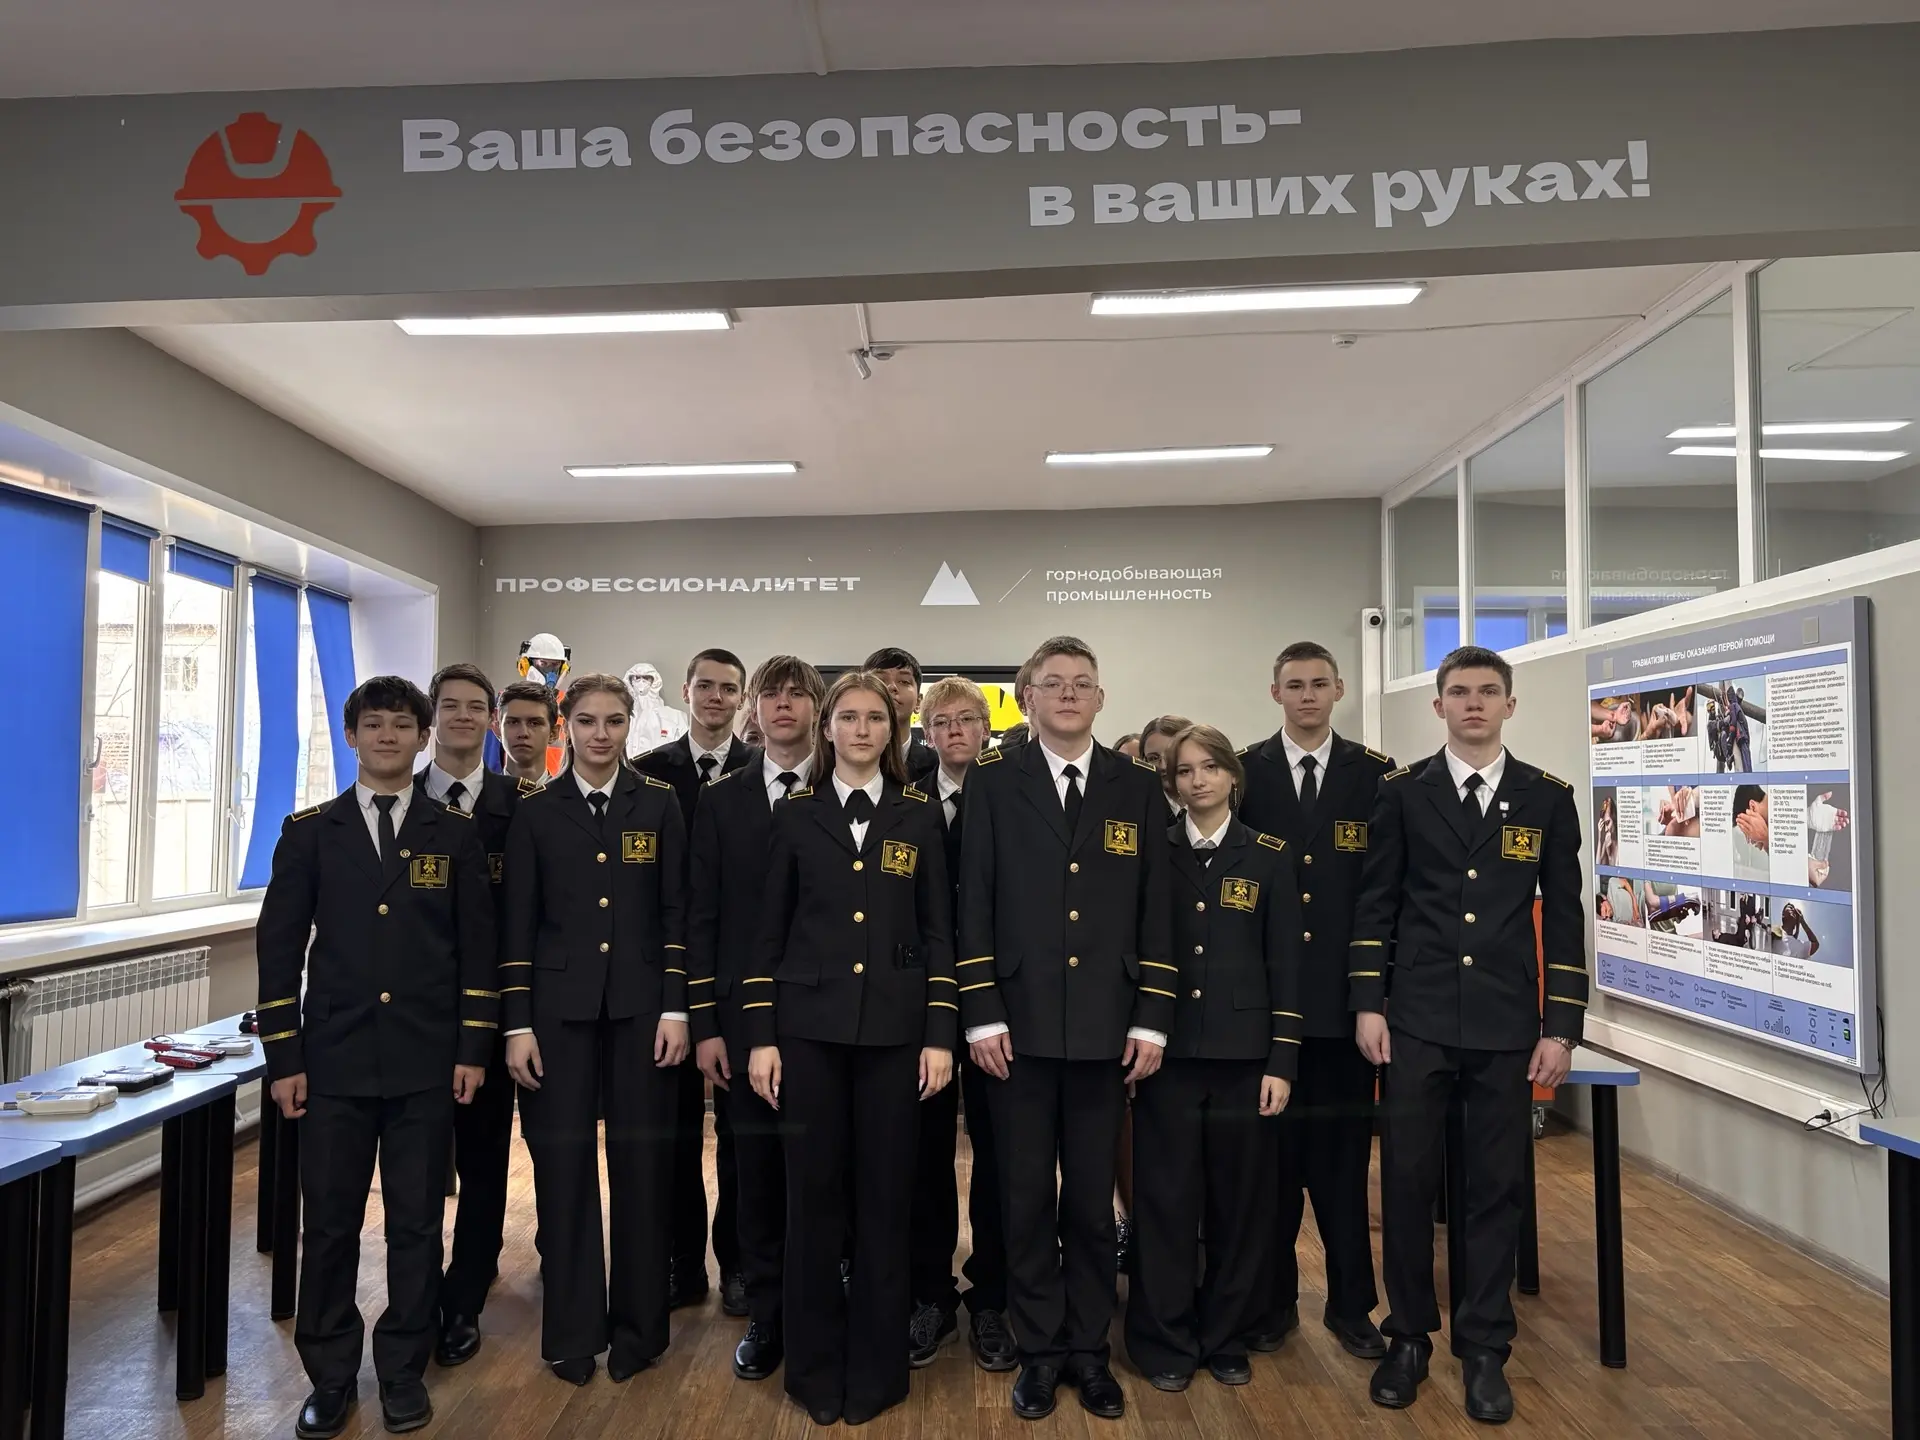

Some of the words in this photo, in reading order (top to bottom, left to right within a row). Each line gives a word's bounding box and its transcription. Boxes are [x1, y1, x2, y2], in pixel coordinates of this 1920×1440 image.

[402, 119, 632, 172] Ваша
[649, 105, 1302, 165] безопасность-
[1029, 186, 1075, 227] в
[1093, 174, 1357, 224] ваших
[1372, 140, 1651, 228] руках!
[495, 577, 861, 593] ПРОФЕССИОНАЛИТЕТ
[1046, 566, 1222, 584] горнодобывающая
[1046, 588, 1213, 604] промышленность
[1632, 655, 1664, 668] ТРАВМАТИЗМ
[1670, 652, 1685, 662] МЕРЫ
[1687, 645, 1717, 658] ОКАЗАНИЯ
[1718, 639, 1744, 653] ПЕРВОЙ
[1745, 633, 1775, 649] ПОМОЩИ
